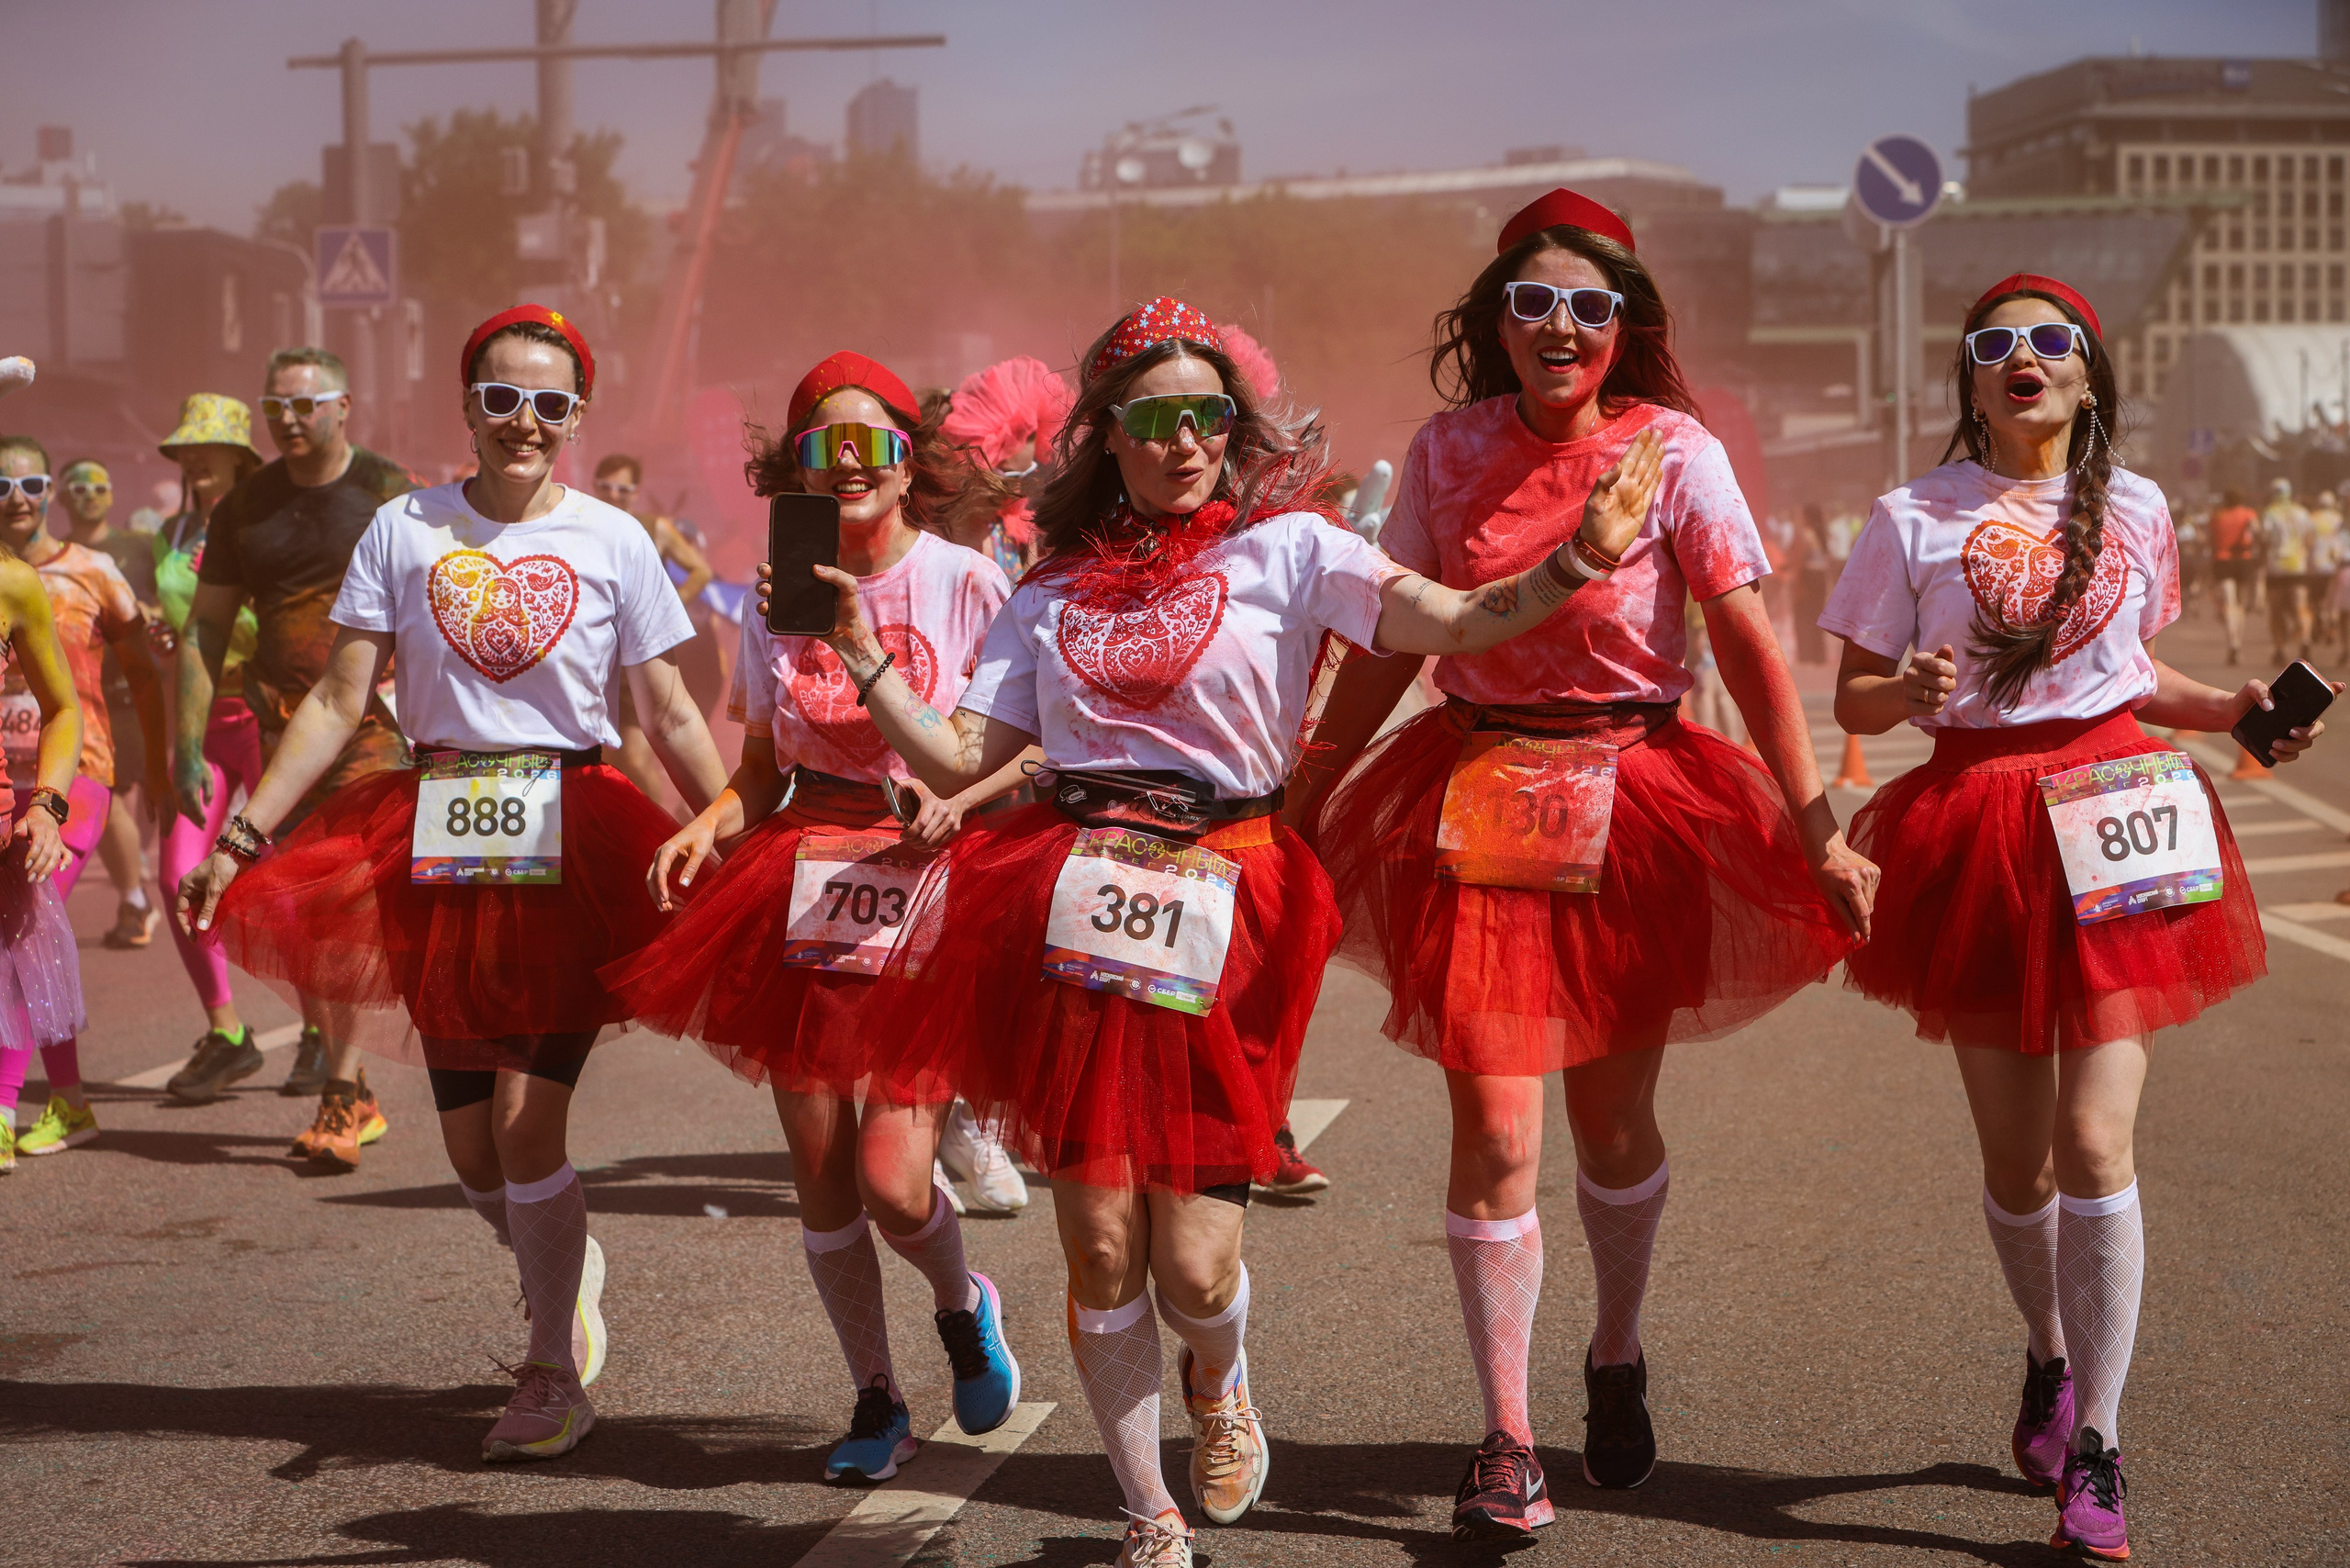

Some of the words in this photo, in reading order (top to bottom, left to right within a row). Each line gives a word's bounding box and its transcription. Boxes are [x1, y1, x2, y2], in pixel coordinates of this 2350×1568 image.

[497, 767, 558, 780] 2026
[2055, 753, 2186, 792] КРАСОЧНЫЙ
[2062, 781, 2131, 801] ЗАБЕГ
[2138, 770, 2195, 789] 2026
[446, 797, 526, 836] 888
[1487, 790, 1569, 839] 130
[2096, 805, 2178, 862] 807
[1084, 848, 1157, 867] ЗАБЕГ
[1164, 864, 1233, 894] 2026
[1088, 831, 1227, 879] КРАСОЧНЫЙ
[825, 881, 908, 927] 703
[1091, 883, 1184, 948] 381
[1158, 988, 1176, 996] СБЕР
